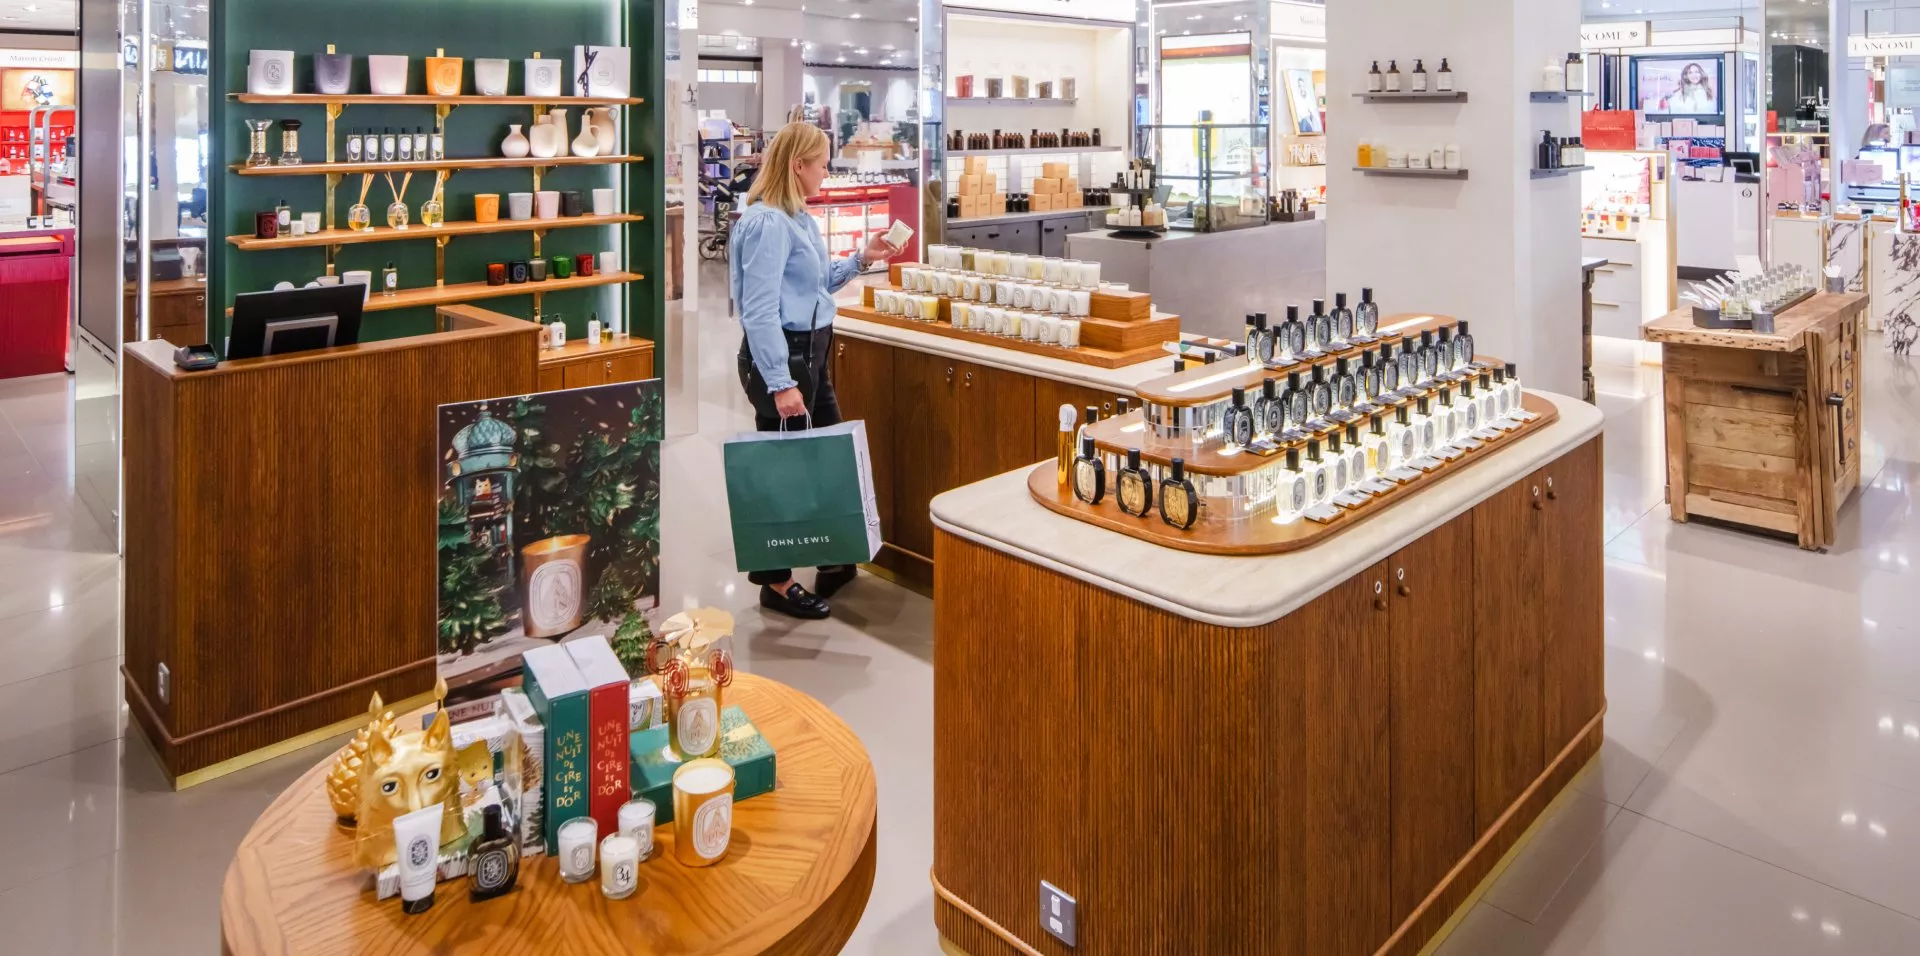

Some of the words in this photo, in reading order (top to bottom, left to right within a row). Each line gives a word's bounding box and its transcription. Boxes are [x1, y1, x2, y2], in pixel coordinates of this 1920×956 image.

[717, 202, 730, 232] M&S
[767, 538, 794, 548] JOHN
[797, 535, 830, 545] LEWIS
[598, 720, 622, 735] UNE
[557, 730, 581, 746] UNE
[597, 733, 623, 750] NUIT
[556, 744, 582, 761] NUIT
[605, 749, 615, 758] DE
[564, 760, 574, 768] DE
[597, 760, 623, 773] CIRE
[555, 771, 582, 784] CIRE
[598, 780, 622, 796] D'OR
[556, 791, 581, 808] D'OR
[616, 867, 631, 885] 34
